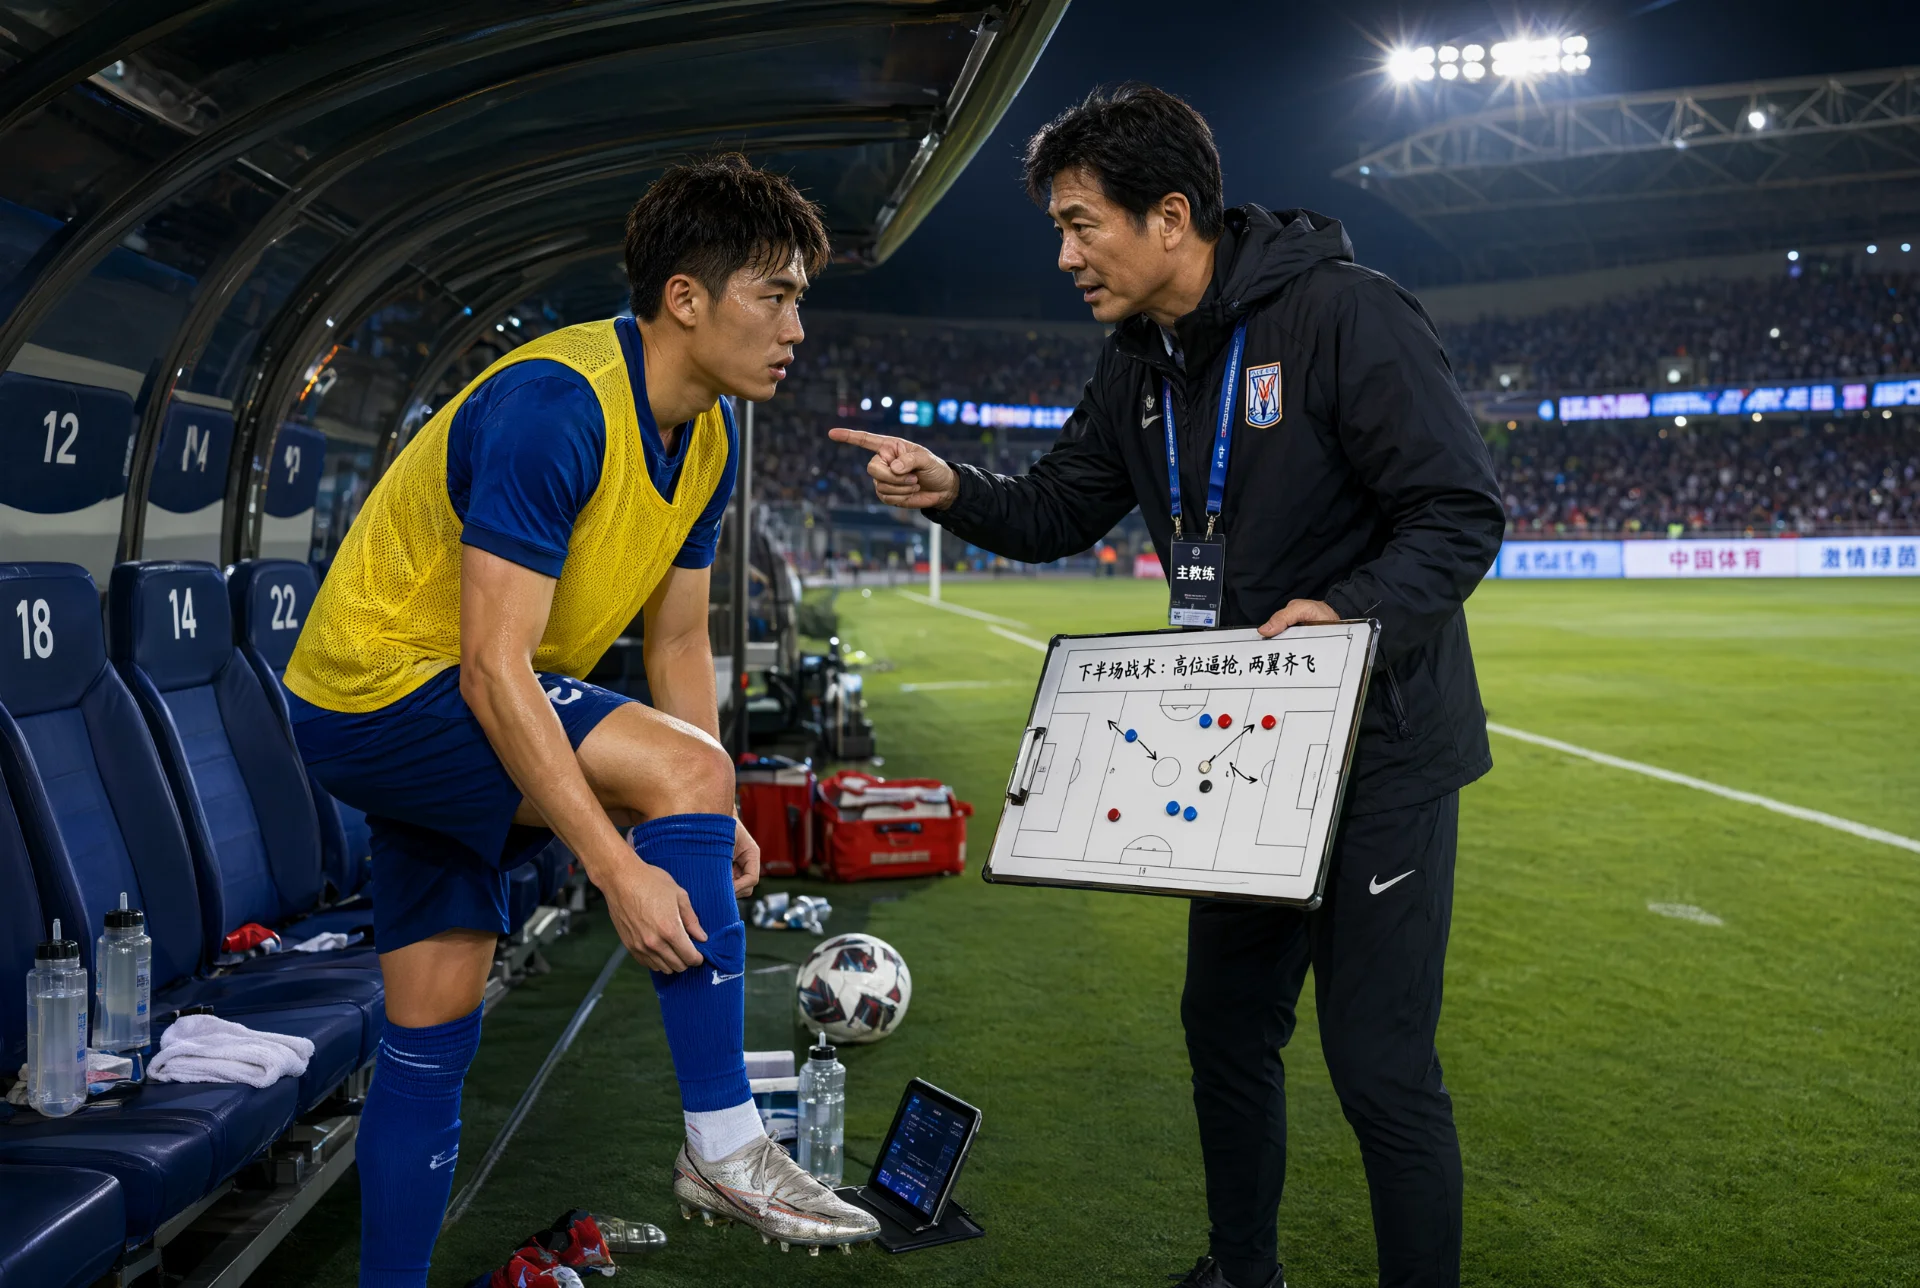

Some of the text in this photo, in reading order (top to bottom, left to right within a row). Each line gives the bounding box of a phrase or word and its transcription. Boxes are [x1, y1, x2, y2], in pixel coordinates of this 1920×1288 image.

[43, 410, 79, 465] 12
[1176, 564, 1215, 581] 主教练
[1669, 548, 1762, 571] 中国体育
[16, 598, 54, 660] 18
[168, 587, 197, 640] 14
[270, 584, 298, 630] 22
